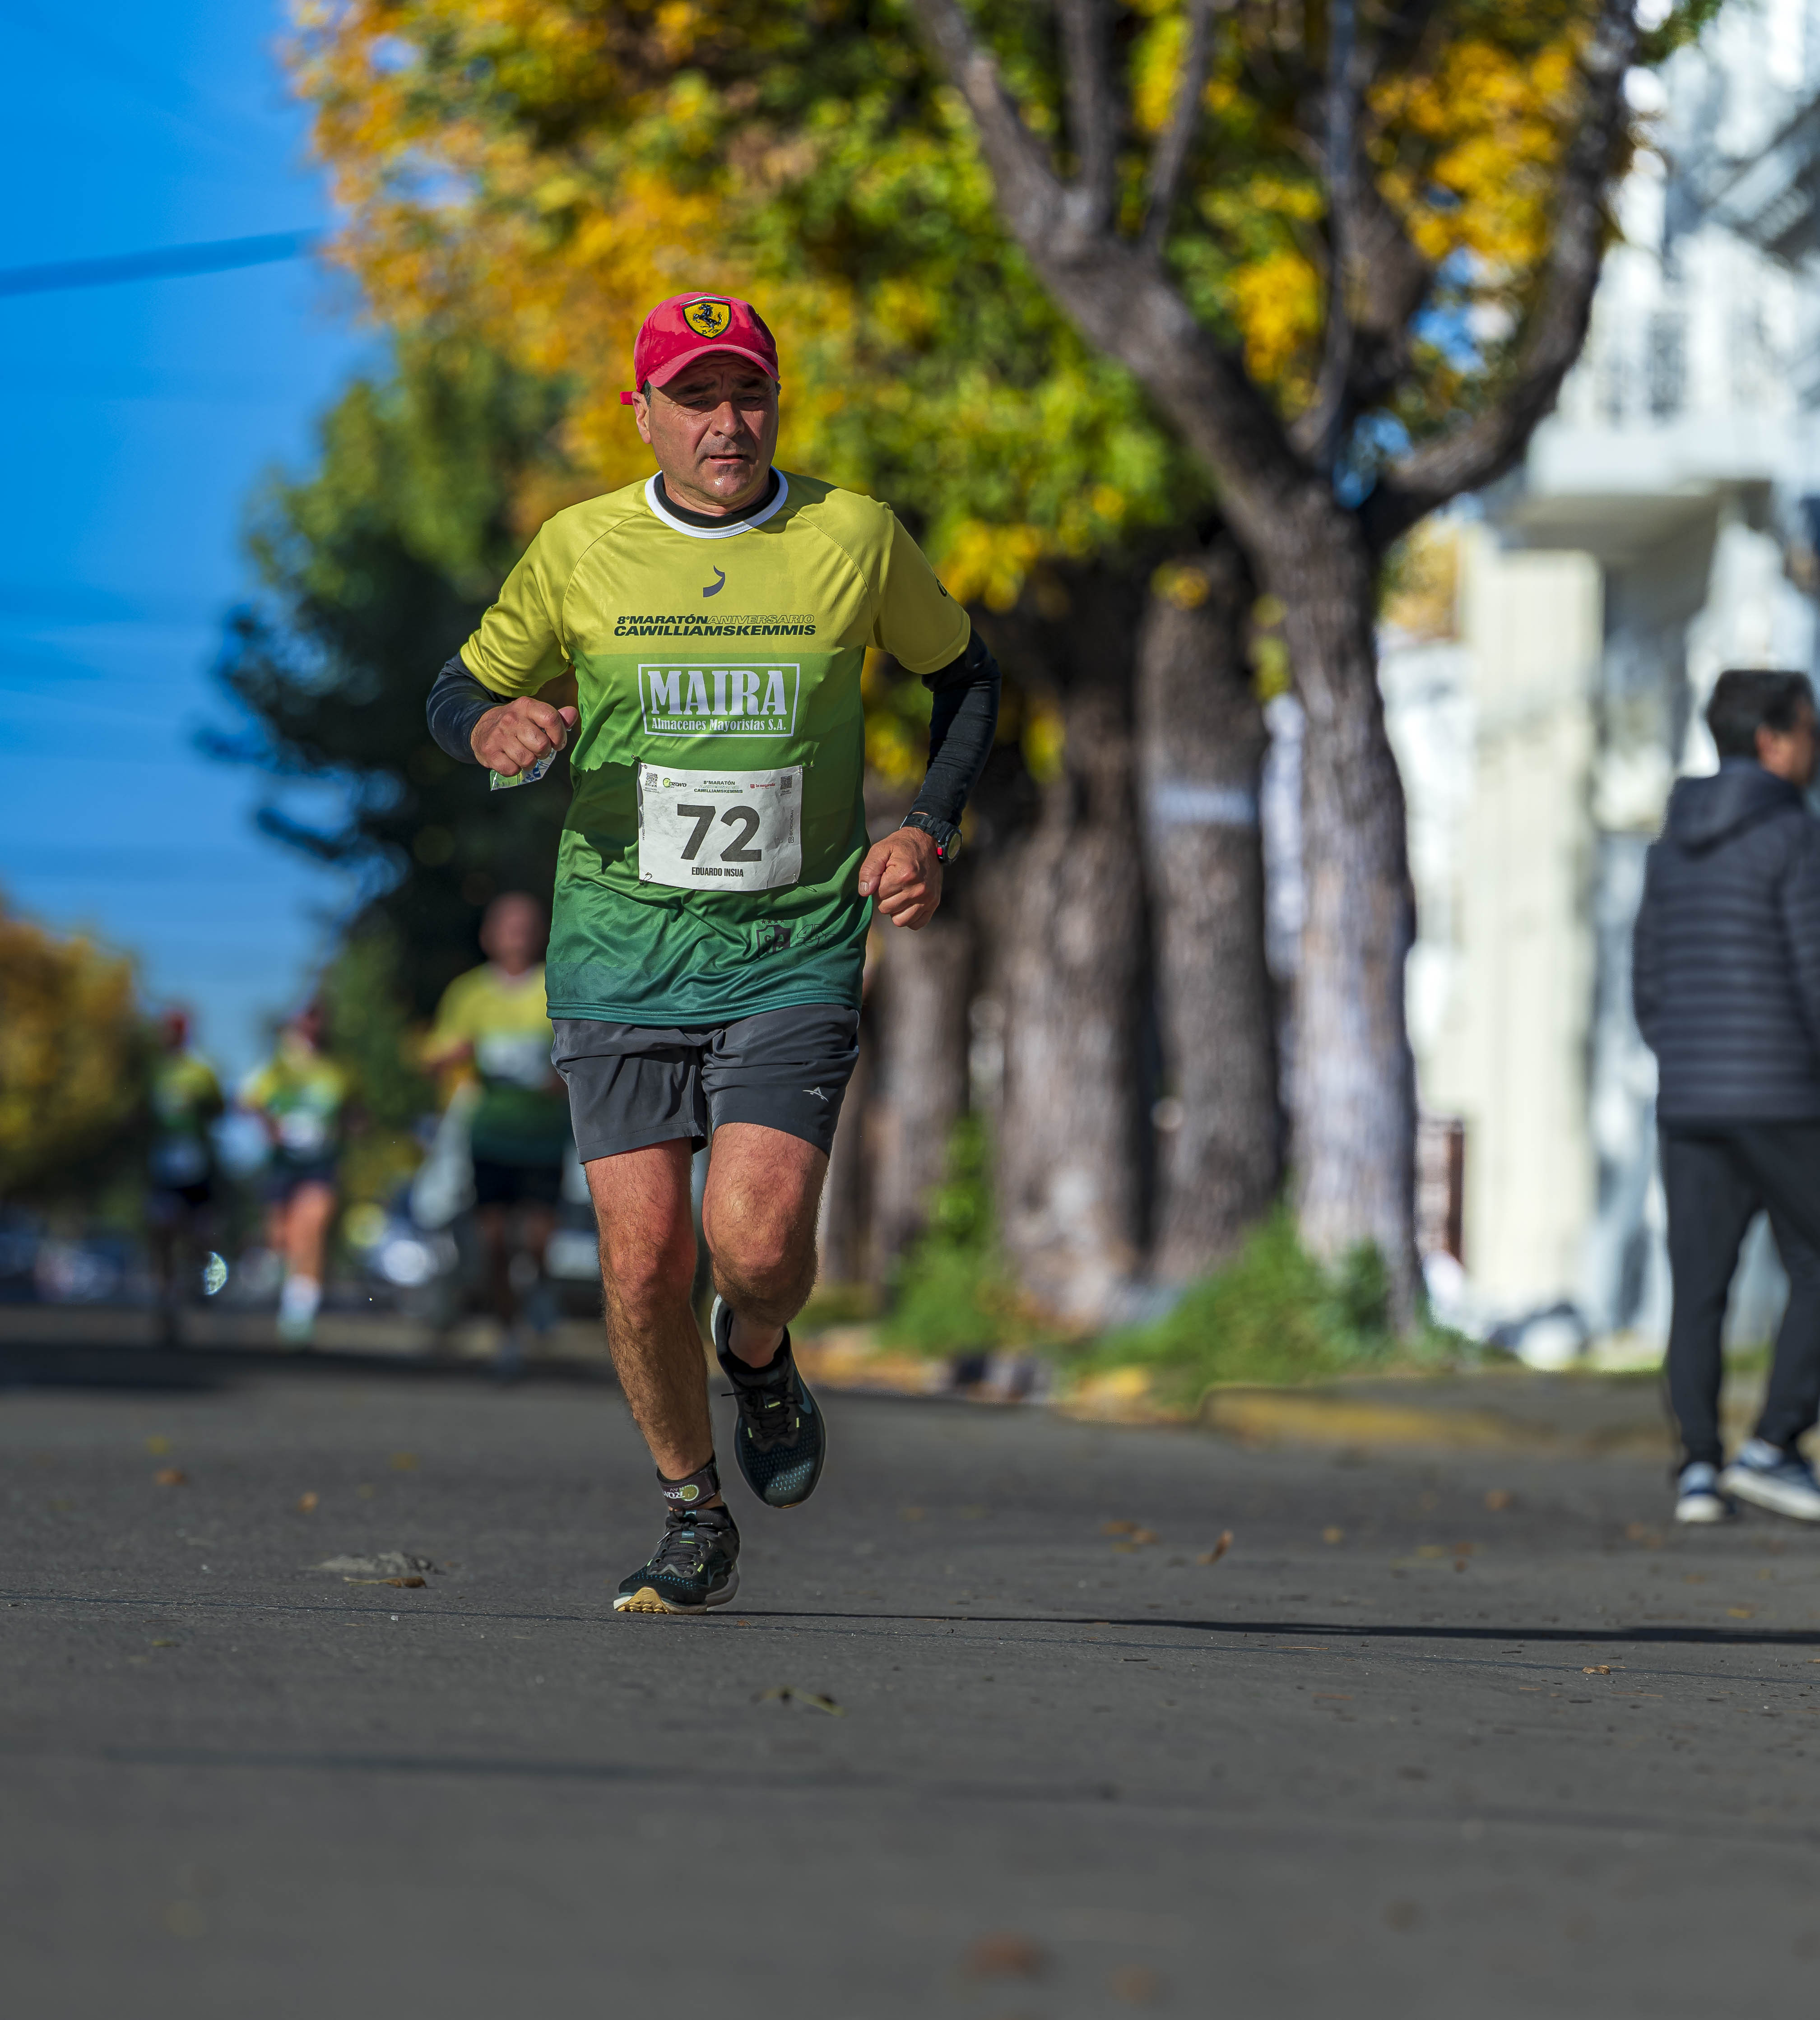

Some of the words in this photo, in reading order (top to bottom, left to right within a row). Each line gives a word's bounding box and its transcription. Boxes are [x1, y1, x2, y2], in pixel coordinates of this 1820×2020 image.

[707, 615, 814, 624] ANIVERSARIO
[614, 625, 816, 636] CAWILLIAMSKEMMIS
[647, 671, 787, 715] MAIRA
[652, 718, 706, 730] Almacenes
[709, 719, 765, 732] Mayoristas
[768, 719, 786, 730] S.A.
[677, 804, 762, 862] 72
[692, 867, 722, 876] EDUARDO
[724, 868, 744, 877] INSUA
